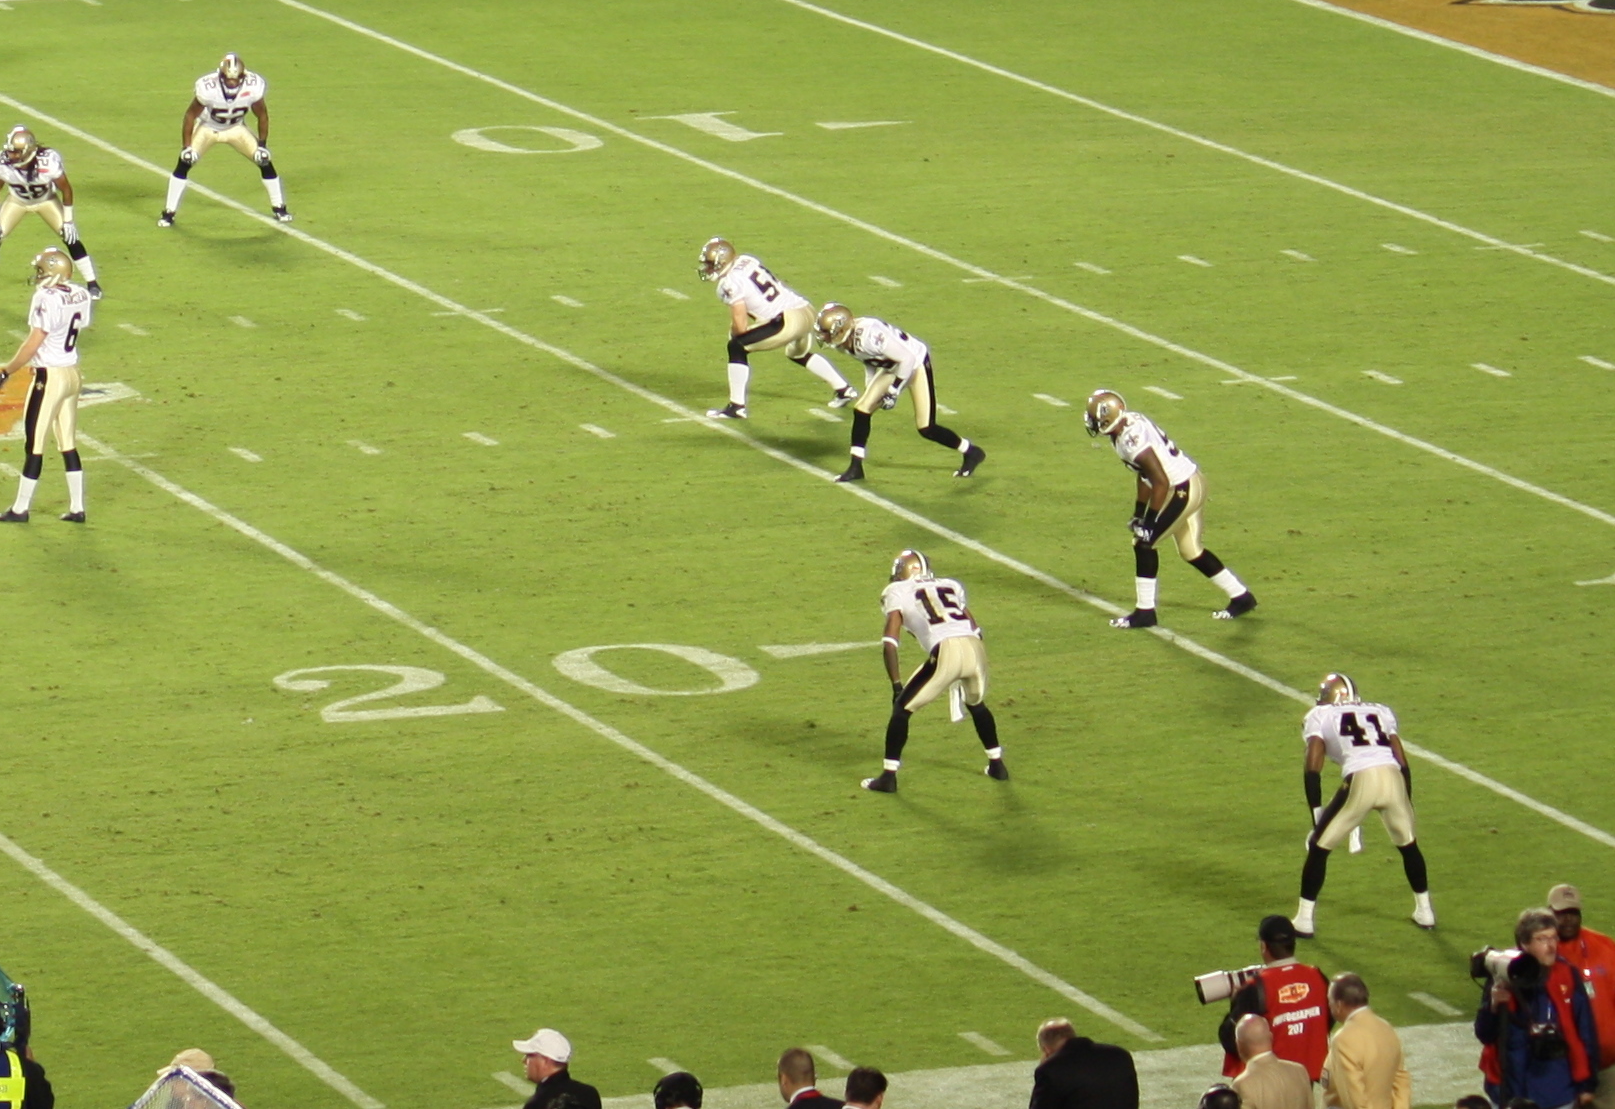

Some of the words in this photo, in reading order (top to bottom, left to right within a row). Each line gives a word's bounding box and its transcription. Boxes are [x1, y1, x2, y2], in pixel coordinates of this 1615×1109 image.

[209, 107, 250, 126] 52
[63, 311, 81, 353] 6
[914, 586, 970, 626] 15
[273, 643, 760, 723] 20
[1338, 710, 1390, 747] 41
[1287, 1022, 1304, 1036] 207
